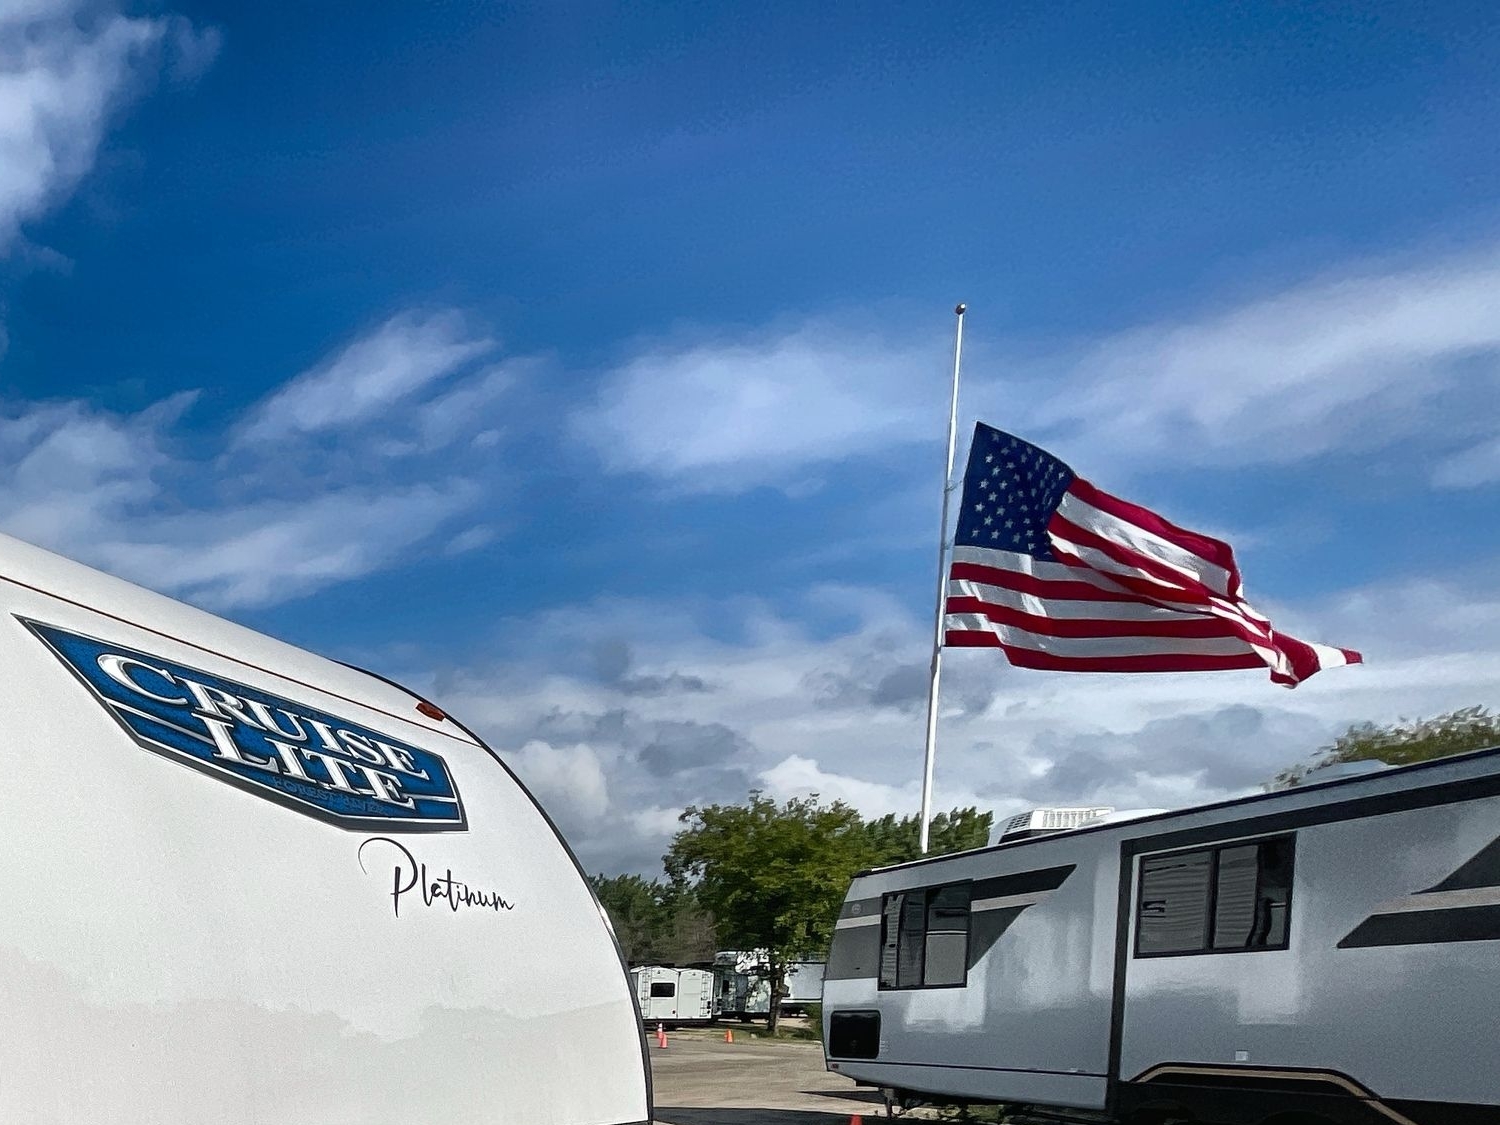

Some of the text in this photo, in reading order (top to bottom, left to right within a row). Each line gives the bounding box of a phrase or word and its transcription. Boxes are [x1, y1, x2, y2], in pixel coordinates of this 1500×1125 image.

[96, 653, 429, 779] CRUISE
[192, 713, 416, 810] LITE
[358, 837, 514, 917] Platinum
